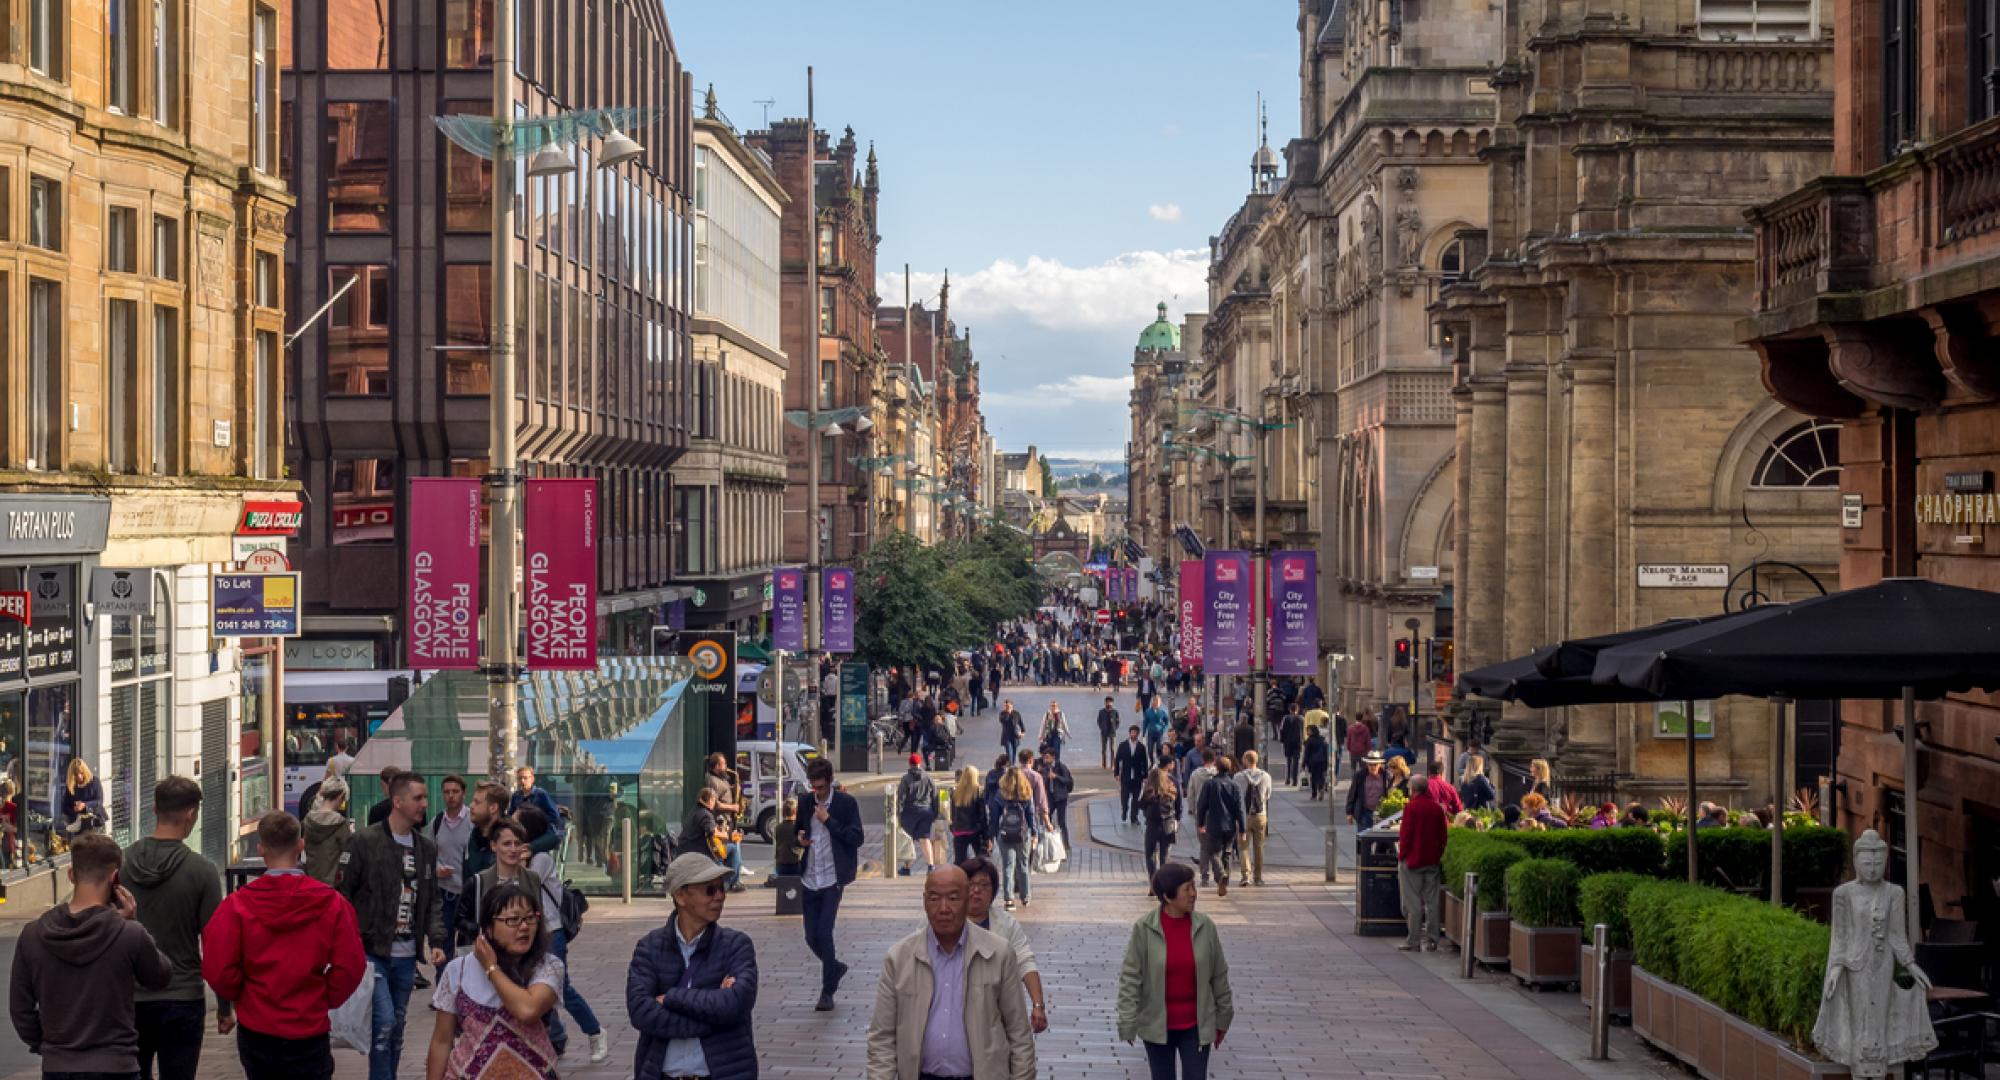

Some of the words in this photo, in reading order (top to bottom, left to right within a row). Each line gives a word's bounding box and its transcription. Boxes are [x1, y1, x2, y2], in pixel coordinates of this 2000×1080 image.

[1915, 494, 2000, 524] CHAOPHRA
[9, 511, 50, 540] TARTAN
[50, 511, 75, 539] PLUS
[255, 556, 276, 564] FISH
[216, 578, 231, 589] To
[233, 577, 252, 589] Let
[1219, 591, 1234, 601] City
[1286, 591, 1303, 601] City
[95, 601, 128, 610] TARTAN
[129, 601, 148, 611] PLUS
[414, 551, 432, 658] GLASGOW
[531, 552, 549, 659] GLASGOW
[1213, 601, 1240, 610] Centre
[1281, 601, 1308, 610] Centre
[452, 583, 470, 659] PEOPLE
[569, 583, 587, 659] PEOPLE
[1217, 611, 1235, 619] Free
[1286, 611, 1304, 619] Free
[216, 620, 239, 630] 0141
[241, 620, 261, 630] 248
[263, 620, 288, 630] 7342
[433, 600, 450, 659] MAKE
[550, 600, 568, 659] MAKE
[1182, 600, 1193, 659] GLASGOW
[1193, 626, 1204, 659] MAKE
[312, 647, 369, 659] LOOK
